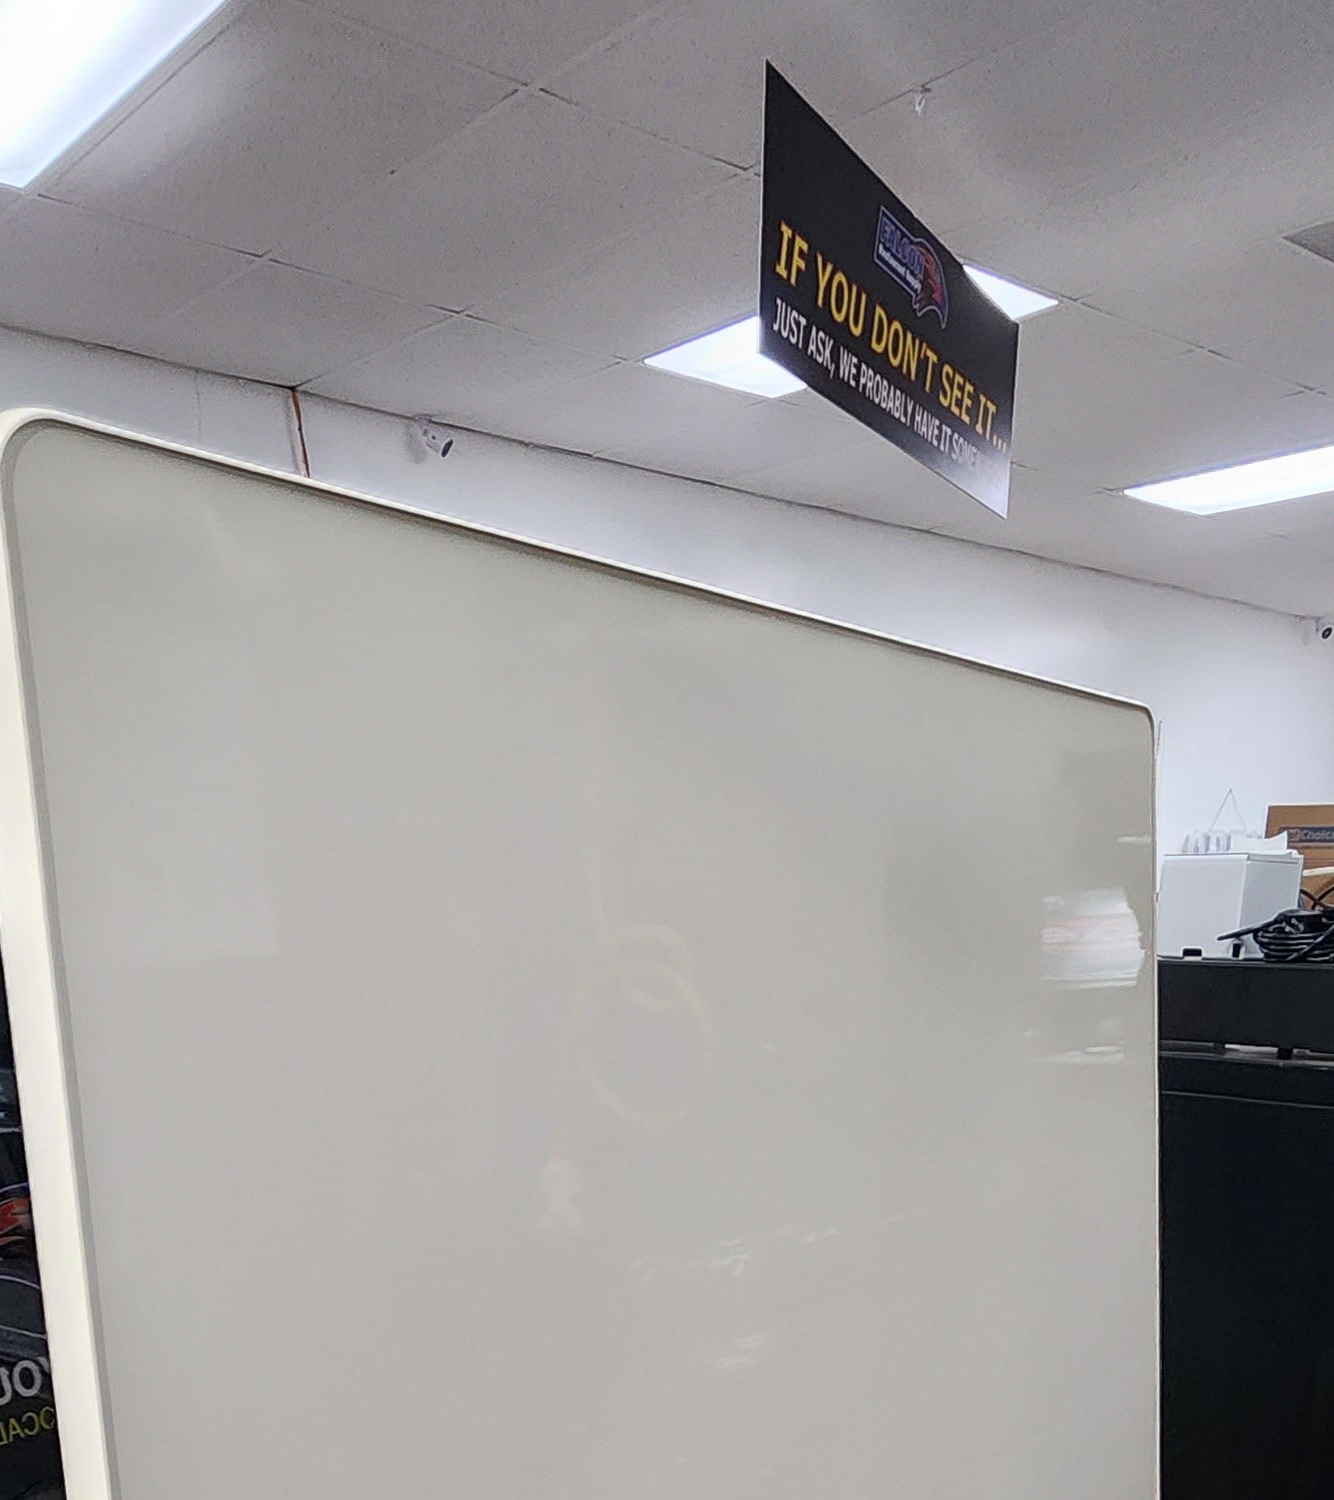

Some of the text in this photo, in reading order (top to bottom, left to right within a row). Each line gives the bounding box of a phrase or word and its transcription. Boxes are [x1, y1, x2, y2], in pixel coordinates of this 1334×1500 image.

[773, 297, 807, 348] JUST
[808, 326, 835, 379] ASK,
[839, 345, 857, 387] WE
[858, 366, 914, 427] PROBABLY
[914, 404, 939, 447] HAVE
[939, 424, 952, 456] IT
[775, 221, 808, 287] IF
[817, 251, 867, 337] YOU
[871, 303, 938, 393] DON'T
[939, 363, 975, 426] SEE
